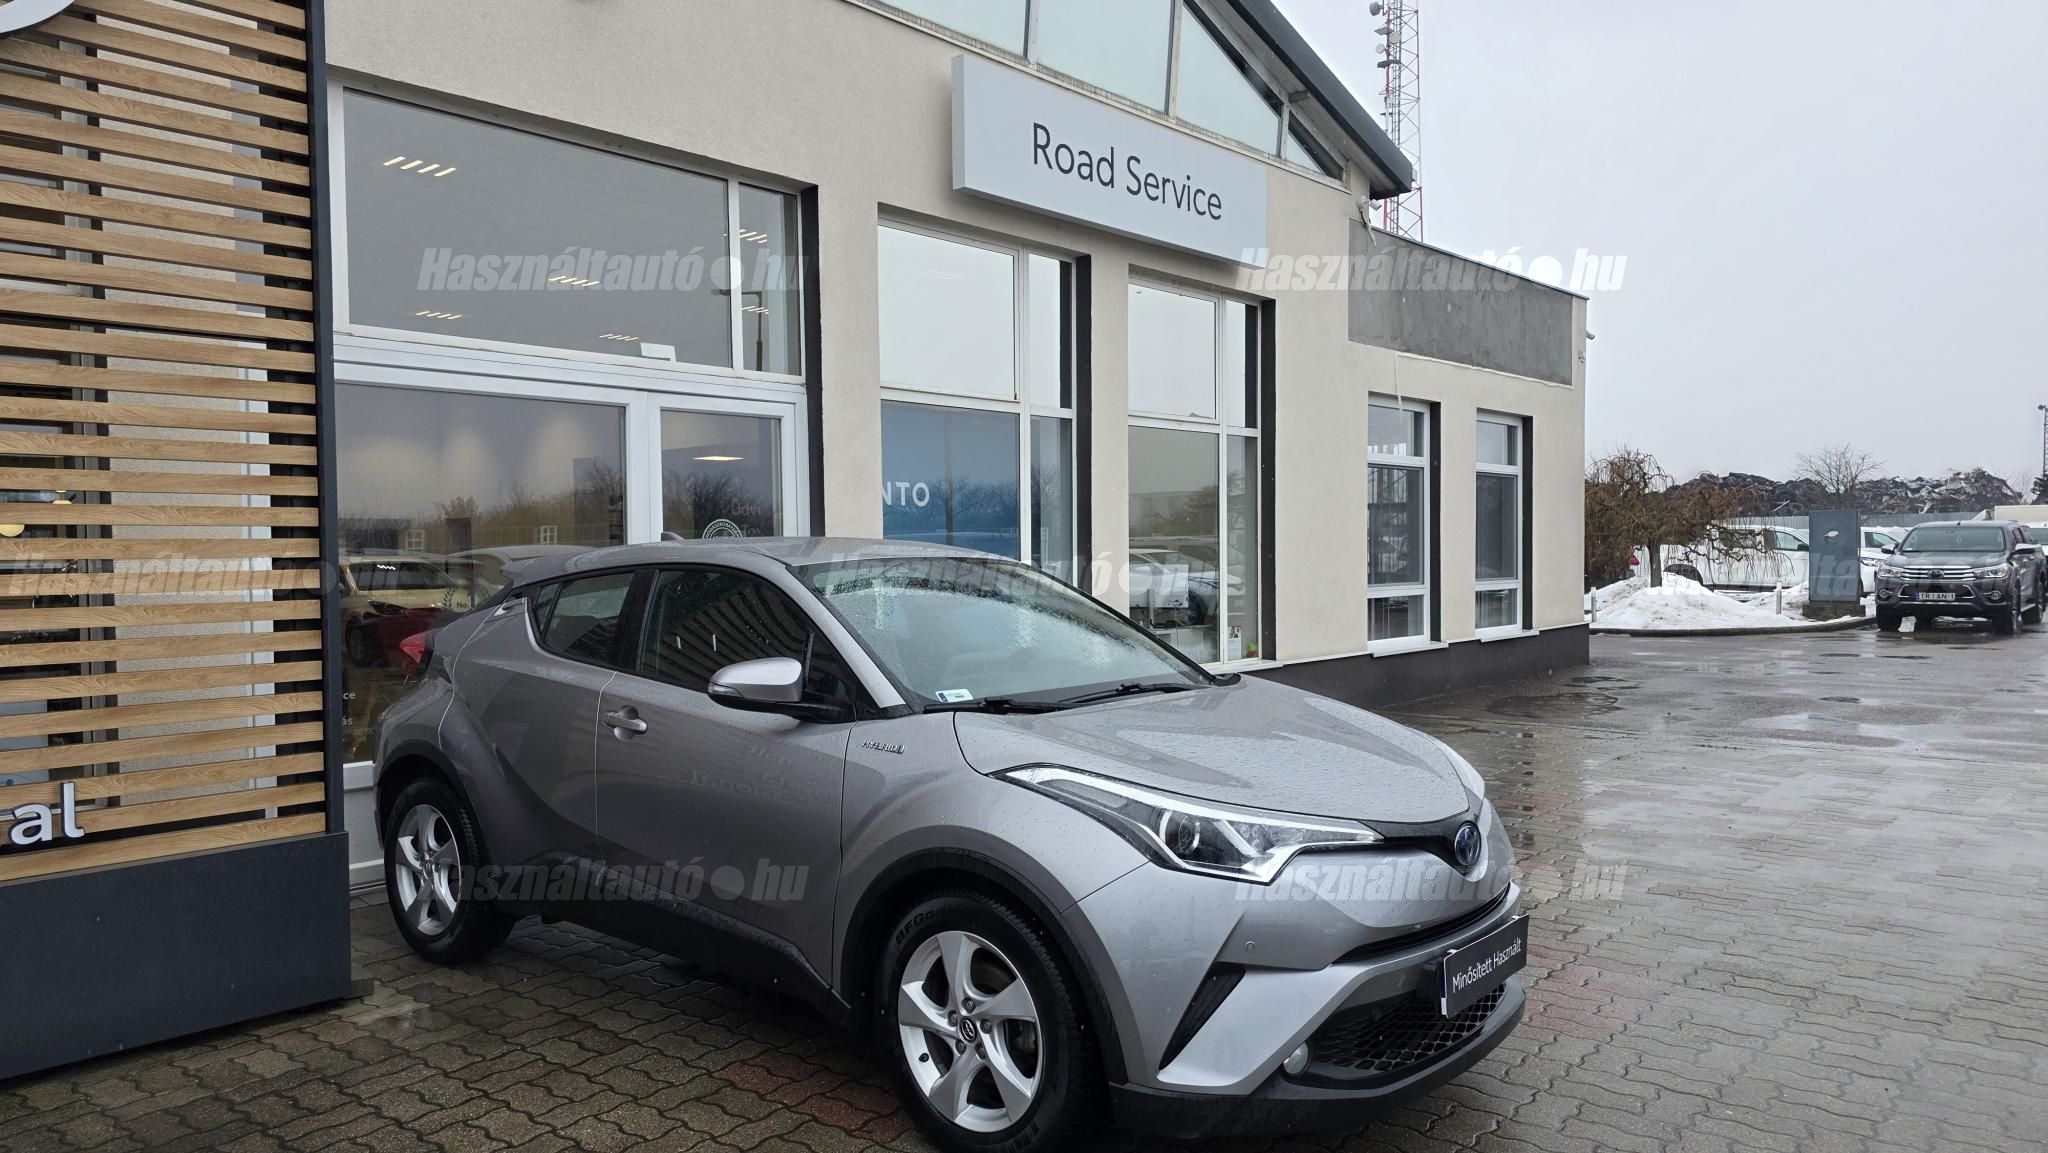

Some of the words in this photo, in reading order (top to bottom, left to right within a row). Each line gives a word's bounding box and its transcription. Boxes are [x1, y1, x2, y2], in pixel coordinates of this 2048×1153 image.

[1033, 122, 1115, 189] Road
[1126, 155, 1222, 221] Service
[1493, 936, 1522, 969] Használt
